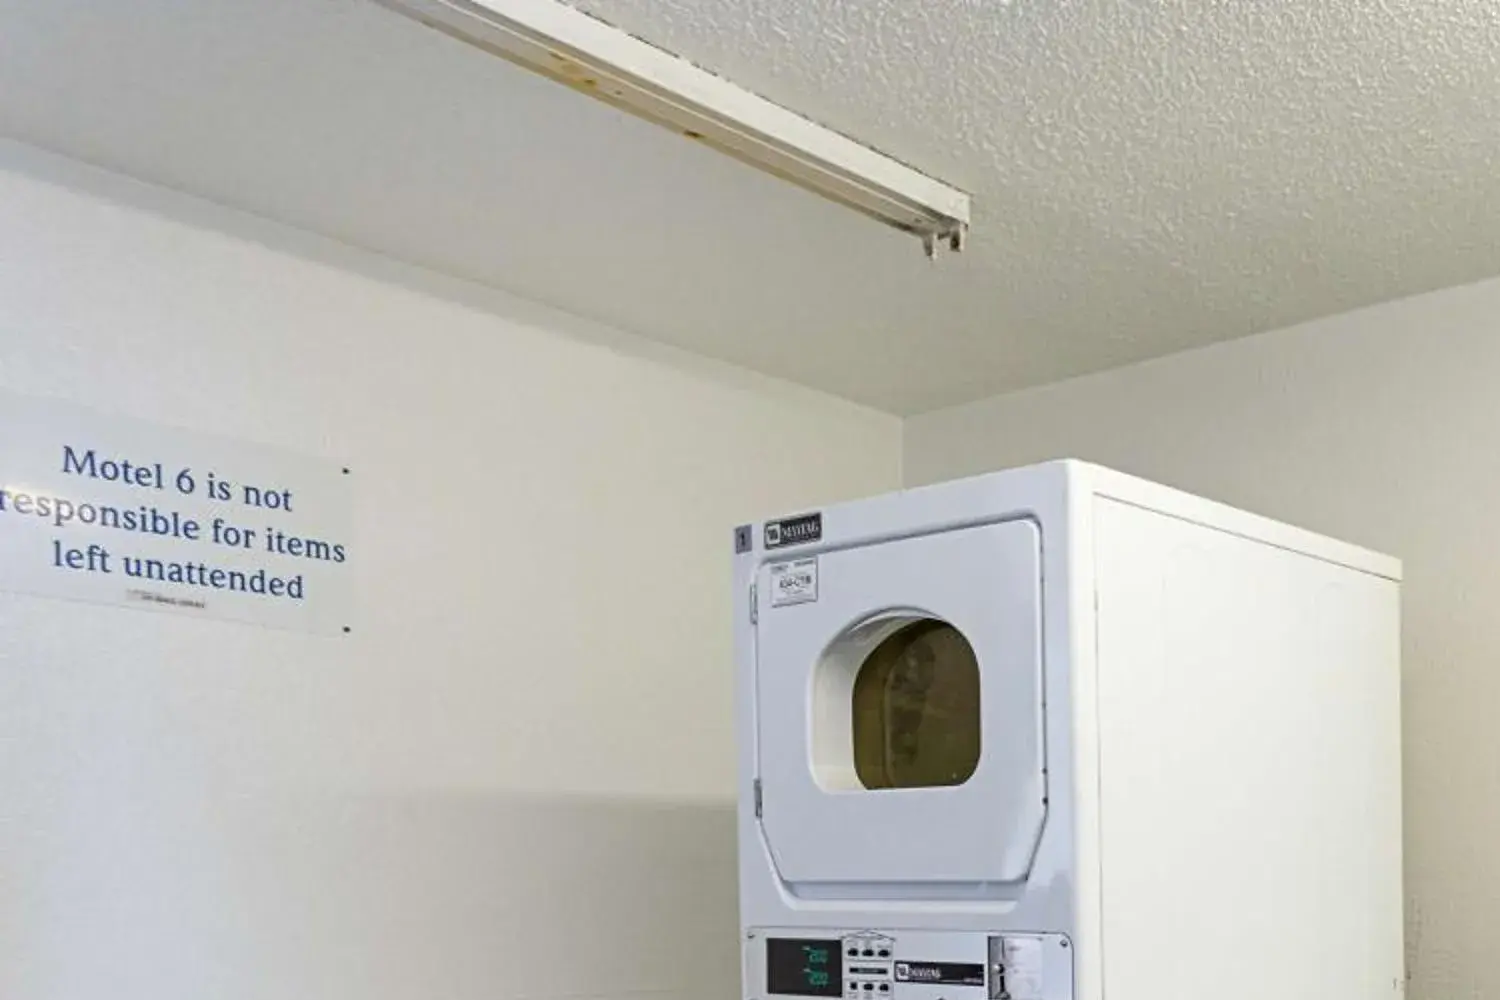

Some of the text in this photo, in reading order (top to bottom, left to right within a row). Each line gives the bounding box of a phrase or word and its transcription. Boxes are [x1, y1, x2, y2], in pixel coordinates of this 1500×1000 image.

[62, 446, 293, 513] Motel 6 is not
[0, 488, 346, 563] responsible for items
[53, 540, 111, 573] left
[124, 554, 304, 600] unattended
